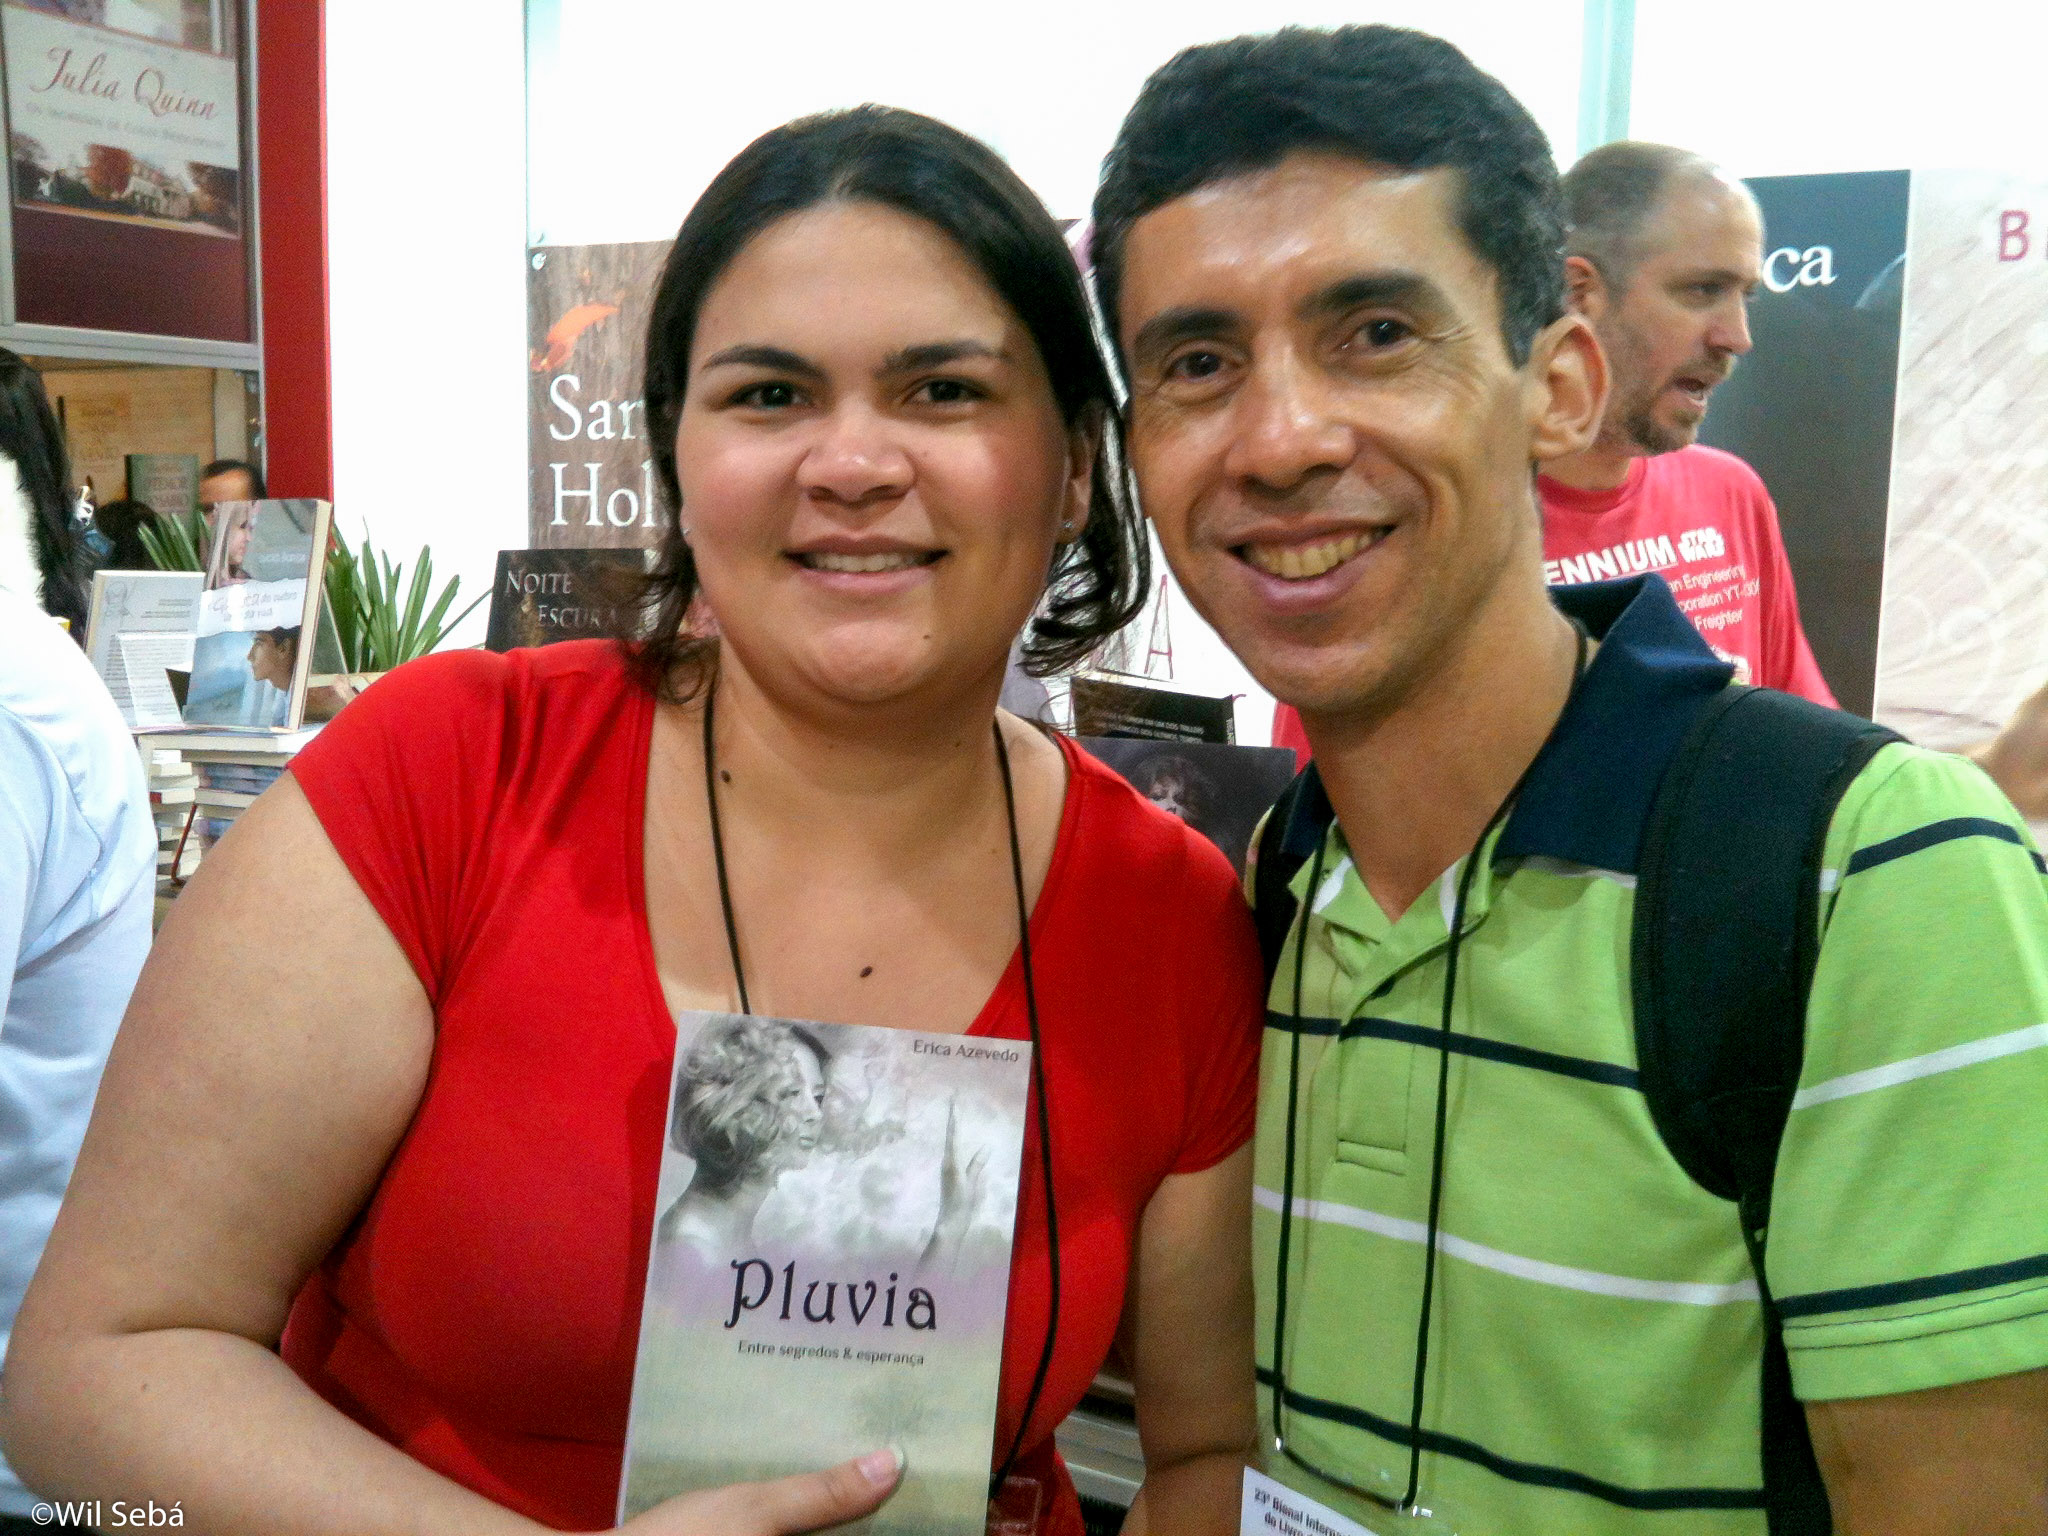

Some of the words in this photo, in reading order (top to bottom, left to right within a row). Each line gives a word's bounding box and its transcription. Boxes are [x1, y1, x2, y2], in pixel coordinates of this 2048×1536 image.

[29, 47, 122, 101] Julia
[134, 67, 218, 121] Quinn
[1762, 245, 1839, 293] ca
[505, 569, 573, 596] NOITE
[913, 1039, 951, 1056] Erica
[955, 1044, 1019, 1063] Azevedo
[724, 1257, 937, 1332] Pluvia
[738, 1340, 775, 1355] Entre
[779, 1343, 839, 1361] segredos
[843, 1346, 853, 1361] &
[856, 1350, 924, 1368] esperança
